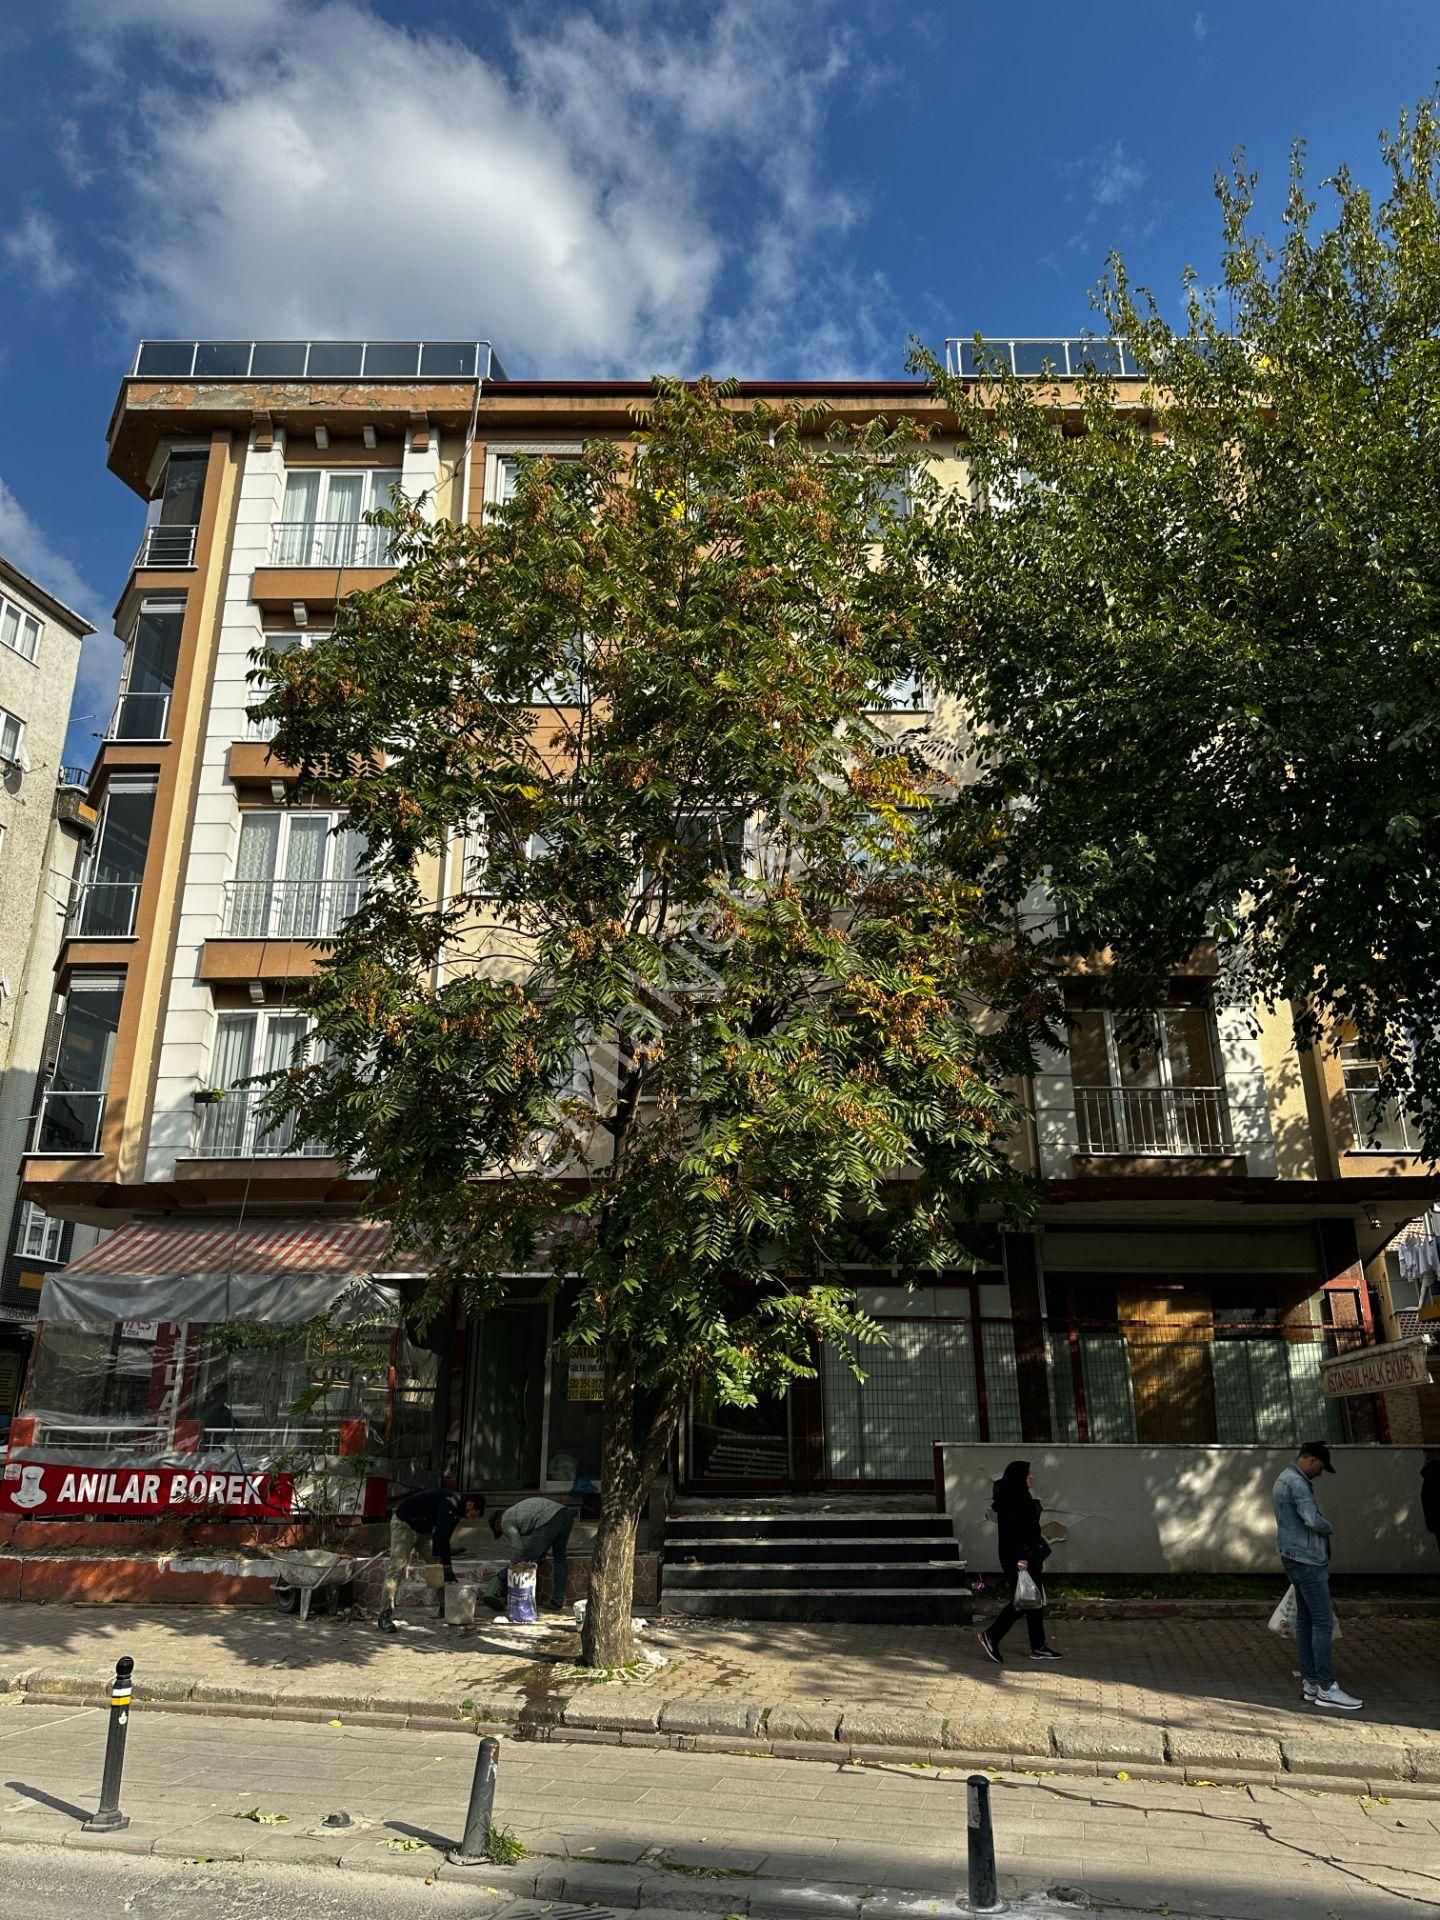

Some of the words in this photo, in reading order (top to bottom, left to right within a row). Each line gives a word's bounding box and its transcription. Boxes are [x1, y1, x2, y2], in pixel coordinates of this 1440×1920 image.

[1363, 1362, 1387, 1387] HALK
[57, 1473, 160, 1503] ANILAR
[169, 1471, 265, 1505] BÖREK
